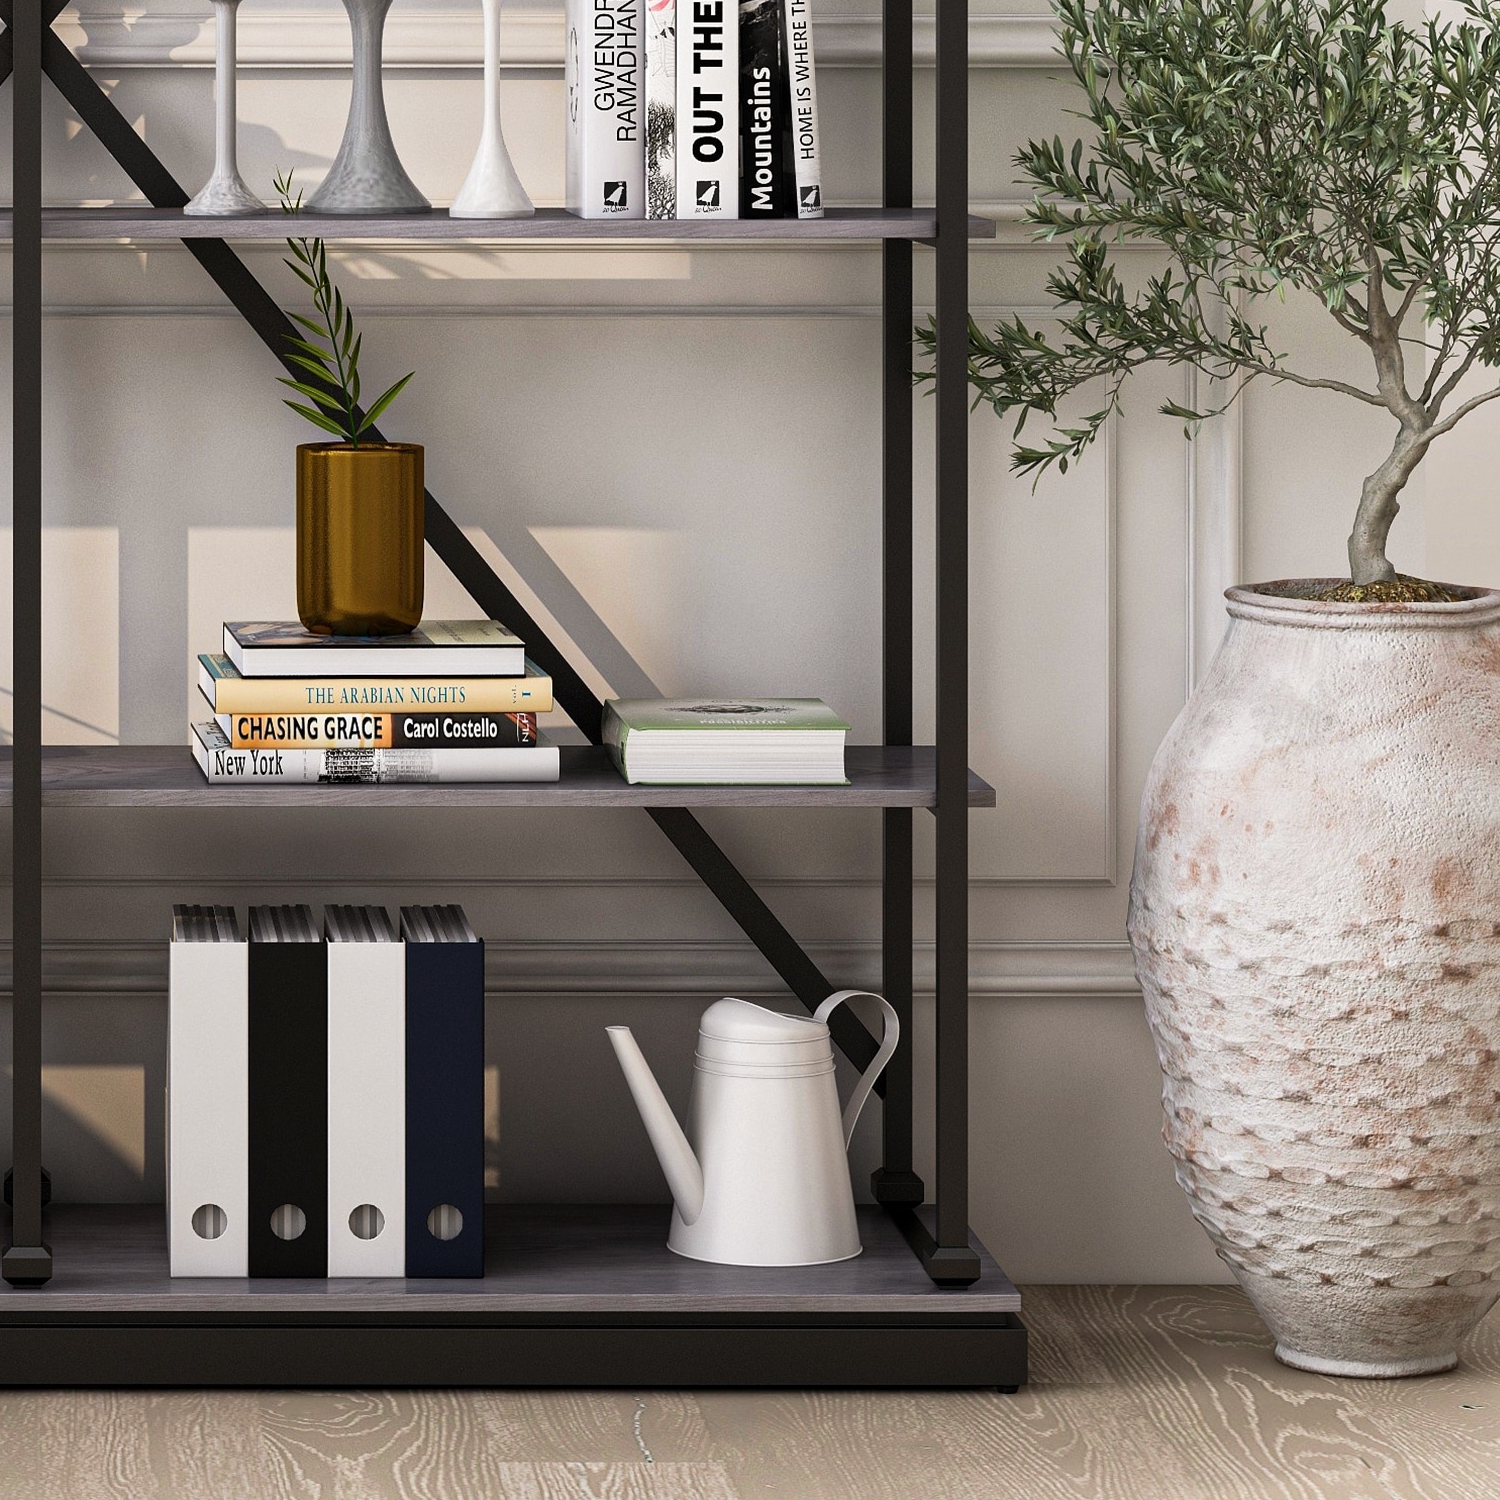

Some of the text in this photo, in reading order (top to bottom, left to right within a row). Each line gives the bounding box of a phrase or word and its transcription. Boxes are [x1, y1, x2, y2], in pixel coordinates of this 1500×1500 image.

[792, 21, 810, 82] WHERE
[796, 87, 811, 101] IS
[692, 87, 724, 162] OUT
[798, 107, 814, 160] HOME
[748, 66, 774, 210] Mountains
[305, 687, 466, 704] THE ARABIAN NIGHTS
[238, 716, 382, 740] CHASING GRACE
[403, 716, 498, 738] Carol Costello
[214, 750, 284, 776] New York
